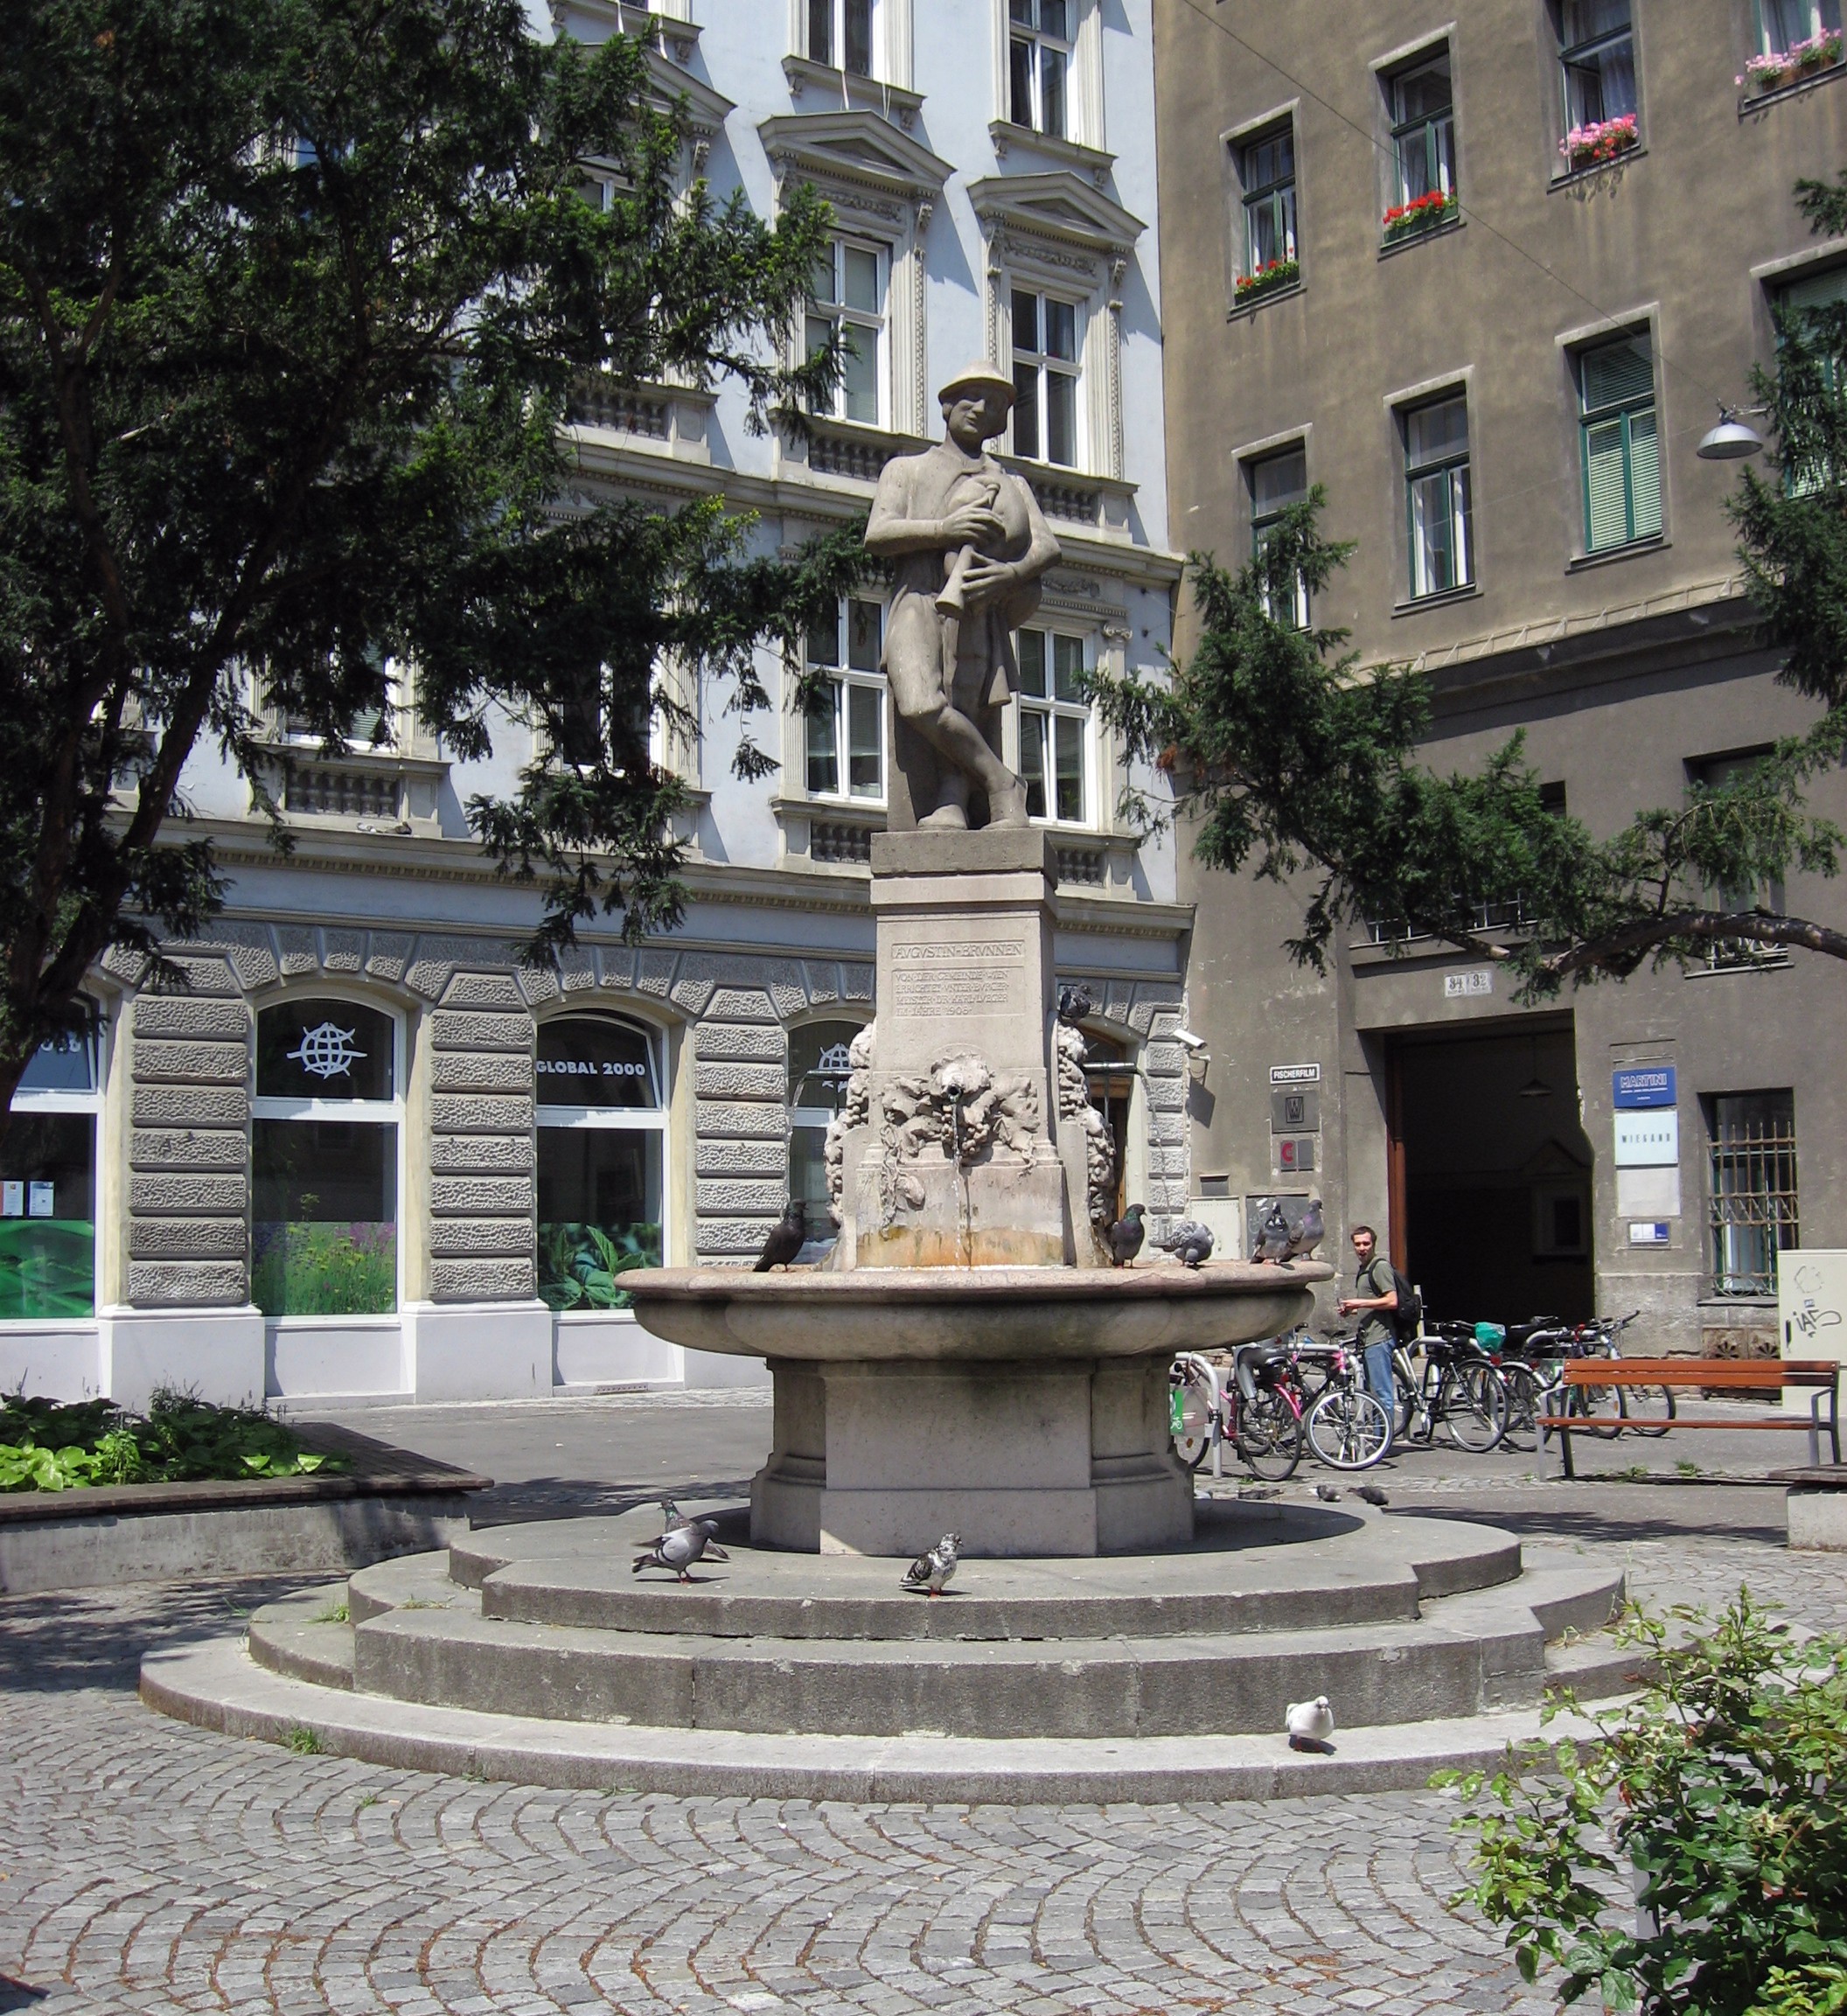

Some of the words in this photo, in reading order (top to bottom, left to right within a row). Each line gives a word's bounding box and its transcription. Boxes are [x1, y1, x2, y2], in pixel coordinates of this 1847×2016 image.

[535, 1060, 598, 1075] GLOBAL
[602, 1062, 645, 1076] 2000
[1274, 1069, 1314, 1079] FISCHERFILM
[1620, 1073, 1667, 1088] MARTINI
